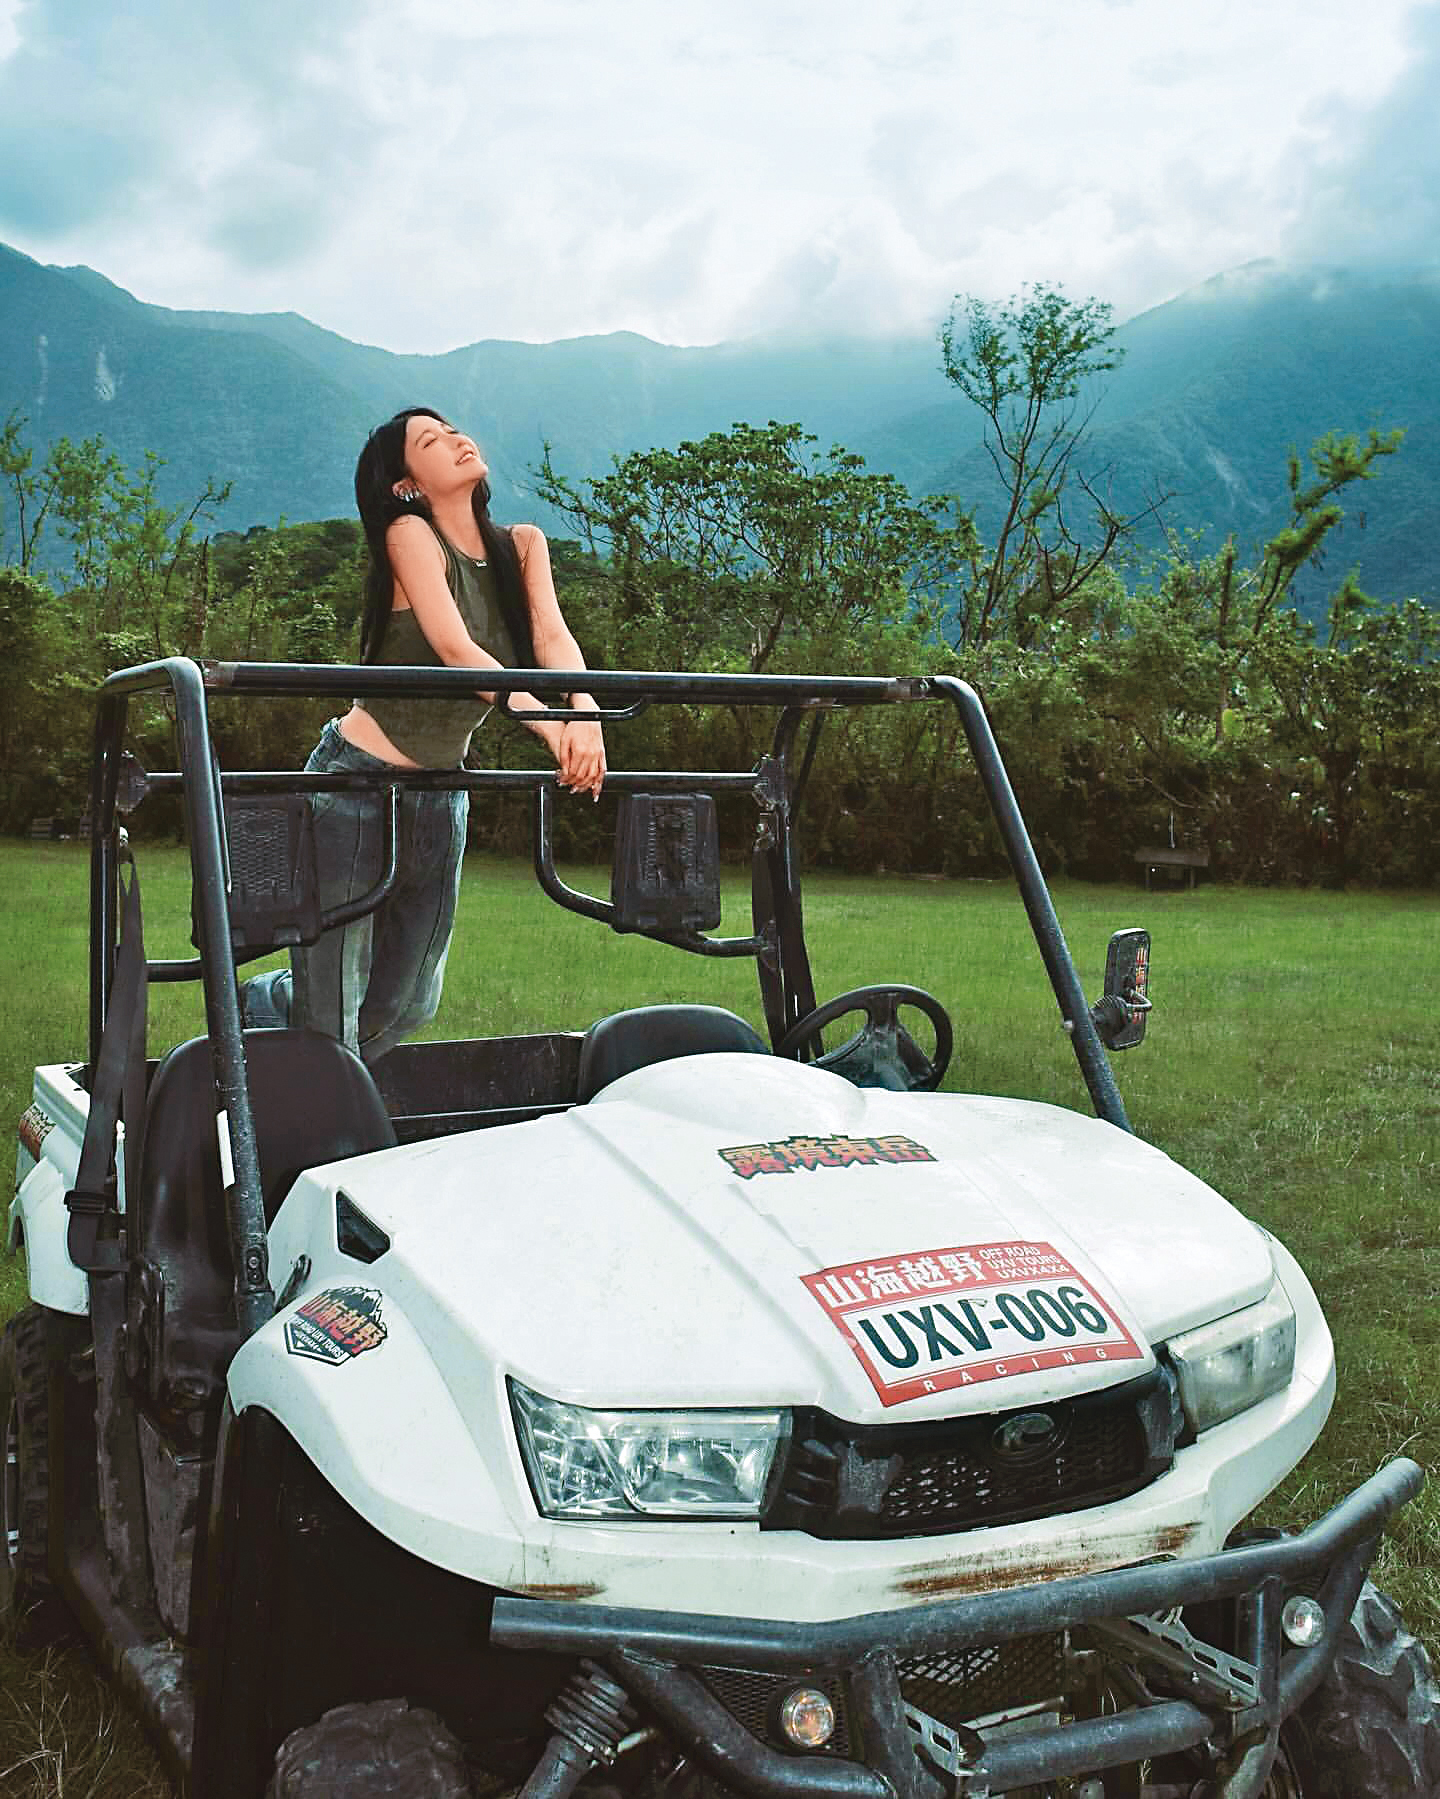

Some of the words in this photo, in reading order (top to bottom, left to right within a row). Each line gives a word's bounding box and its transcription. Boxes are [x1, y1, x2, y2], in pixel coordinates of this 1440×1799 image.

[986, 1258, 1017, 1270] UXV
[1004, 1246, 1040, 1258] ROAD
[815, 1252, 987, 1307] 山海越野
[858, 1286, 1108, 1368] UXV-006
[923, 1348, 1108, 1392] RACING
